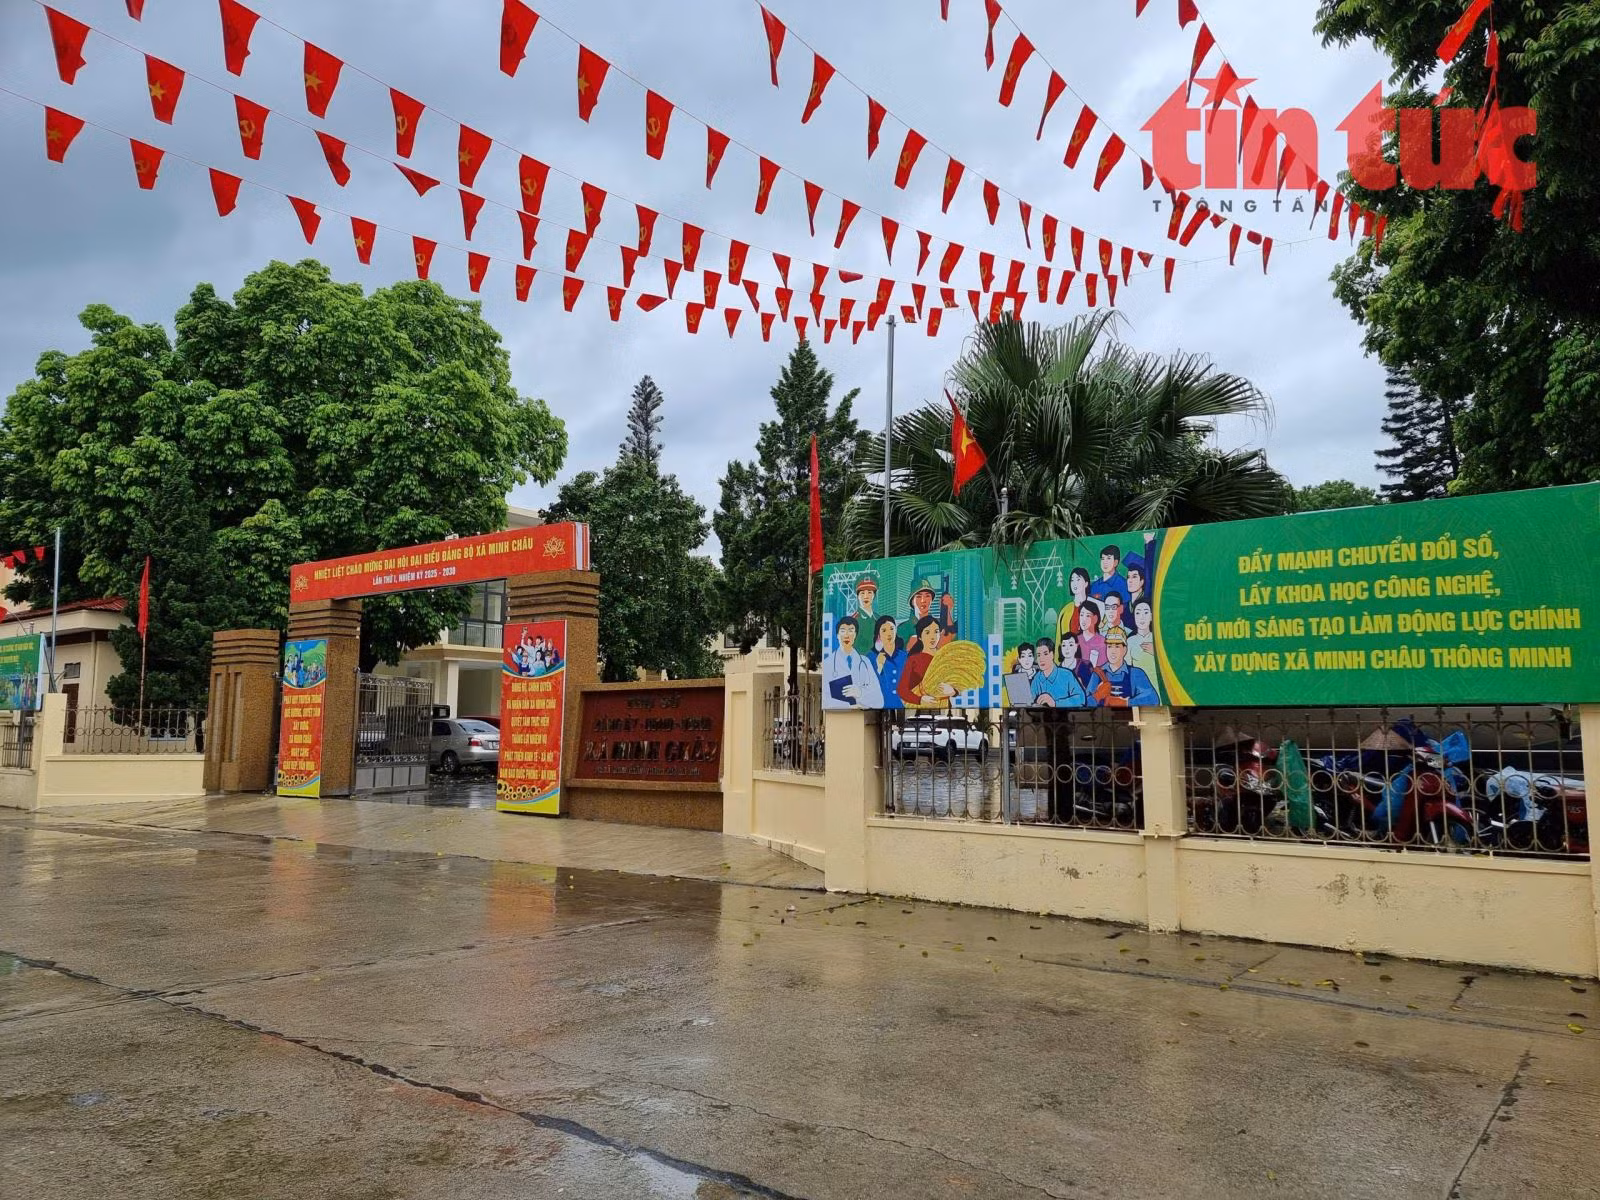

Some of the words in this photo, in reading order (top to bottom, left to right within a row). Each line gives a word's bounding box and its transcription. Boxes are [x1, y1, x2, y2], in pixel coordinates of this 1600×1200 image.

[314, 567, 331, 580] NHIỆT
[332, 565, 344, 579] LIỆT
[346, 563, 362, 575] CHÀO
[364, 560, 382, 573] MỪNG
[384, 558, 396, 572] ĐẠI
[397, 556, 408, 570] HỘI
[410, 554, 422, 568] ĐẠI
[424, 548, 440, 564] BIỂU
[442, 546, 462, 562] ĐẢNG
[464, 544, 474, 560] BỘ
[476, 542, 486, 556] XÃ
[488, 541, 510, 555] MINH
[512, 538, 534, 551] CHÂU
[1238, 547, 1273, 574] ĐẨY
[1278, 549, 1333, 574] MẠNH
[1337, 536, 1417, 567] CHUYỂN
[1422, 533, 1457, 560] ĐỔI
[1463, 530, 1500, 560] SỐ,
[1239, 581, 1271, 606] LẤY
[1276, 584, 1326, 605] KHOA
[1330, 581, 1369, 606] HỌC
[1373, 575, 1431, 599] CÔNG
[1436, 570, 1501, 599] NGHỆ,
[1184, 617, 1213, 641] ĐỔI
[1217, 617, 1251, 640] MỚI
[1255, 613, 1305, 638] SÁNG
[1308, 616, 1346, 640] TẠO
[1350, 611, 1393, 635] LÀM
[1397, 609, 1456, 635] ĐỘNG
[1461, 611, 1504, 635] LỰC
[1509, 604, 1581, 631] CHÍNH
[1193, 650, 1226, 672] XÂY
[1230, 652, 1280, 676] DỰNG
[1284, 648, 1310, 671] XÃ
[1314, 650, 1366, 669] MINH
[1370, 645, 1426, 669] CHÂU
[1429, 643, 1503, 669] THÔNG
[1509, 646, 1572, 669] MINH
